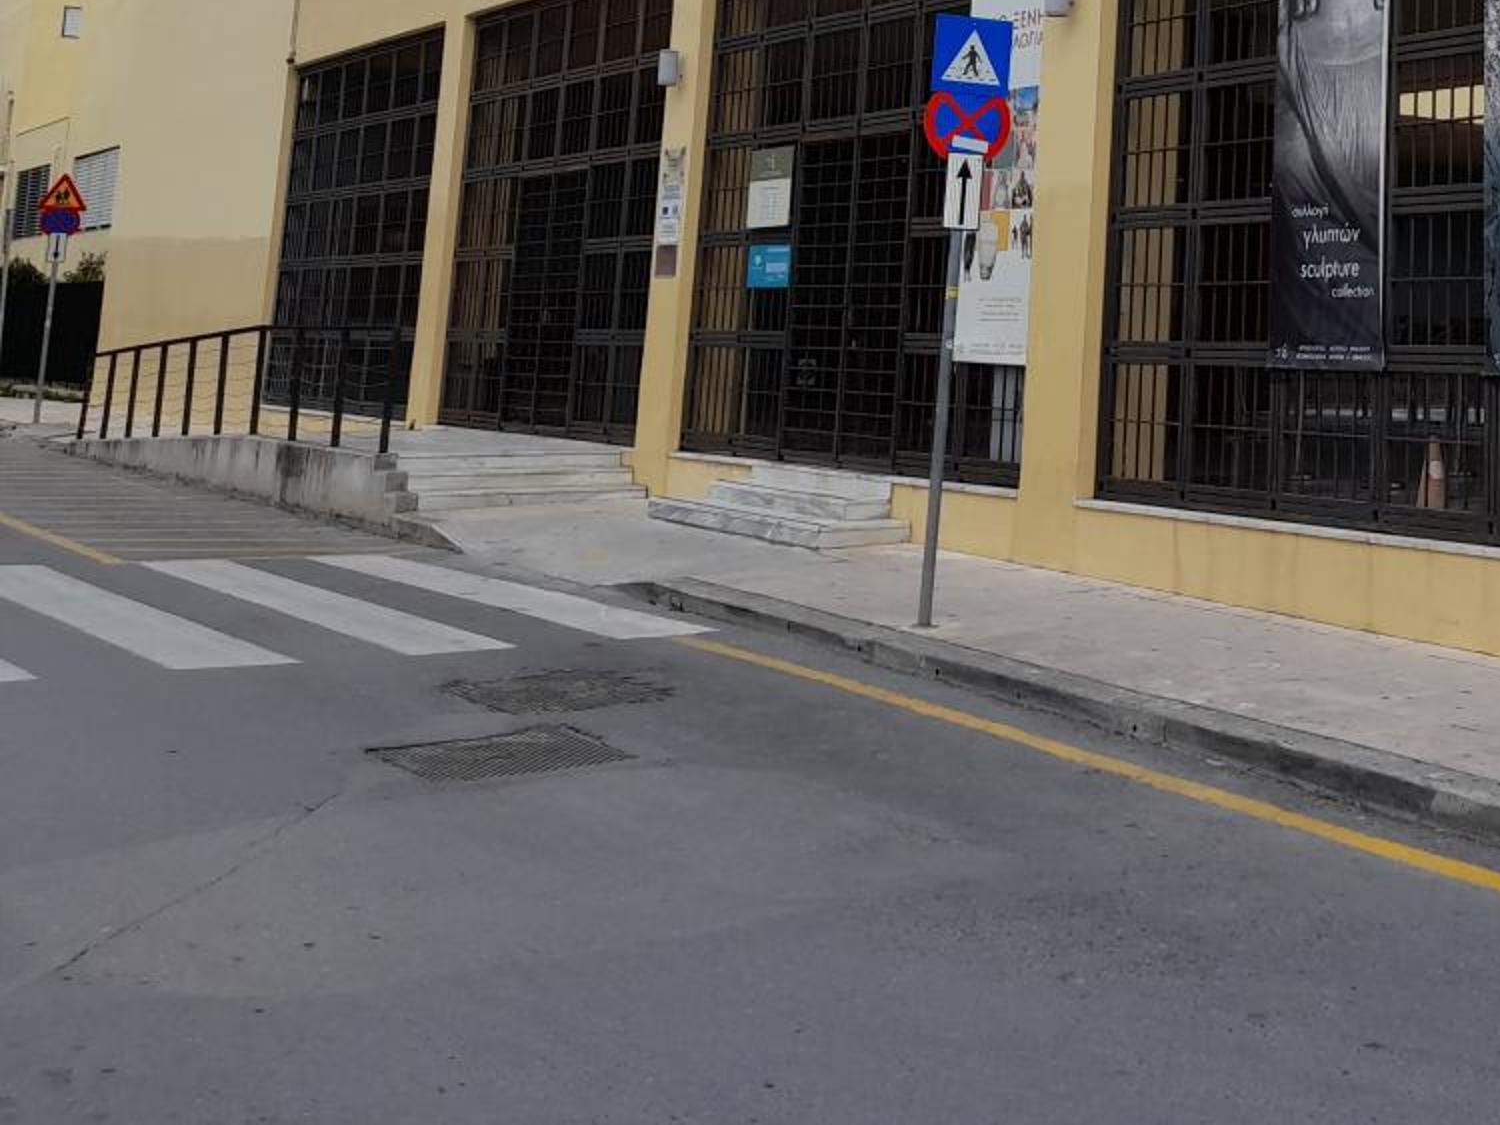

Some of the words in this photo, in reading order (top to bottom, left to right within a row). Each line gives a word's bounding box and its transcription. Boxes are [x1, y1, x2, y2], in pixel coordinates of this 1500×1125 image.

[1303, 222, 1361, 250] γλυπτών
[1300, 255, 1361, 283] sculpture
[1331, 282, 1376, 298] collection
